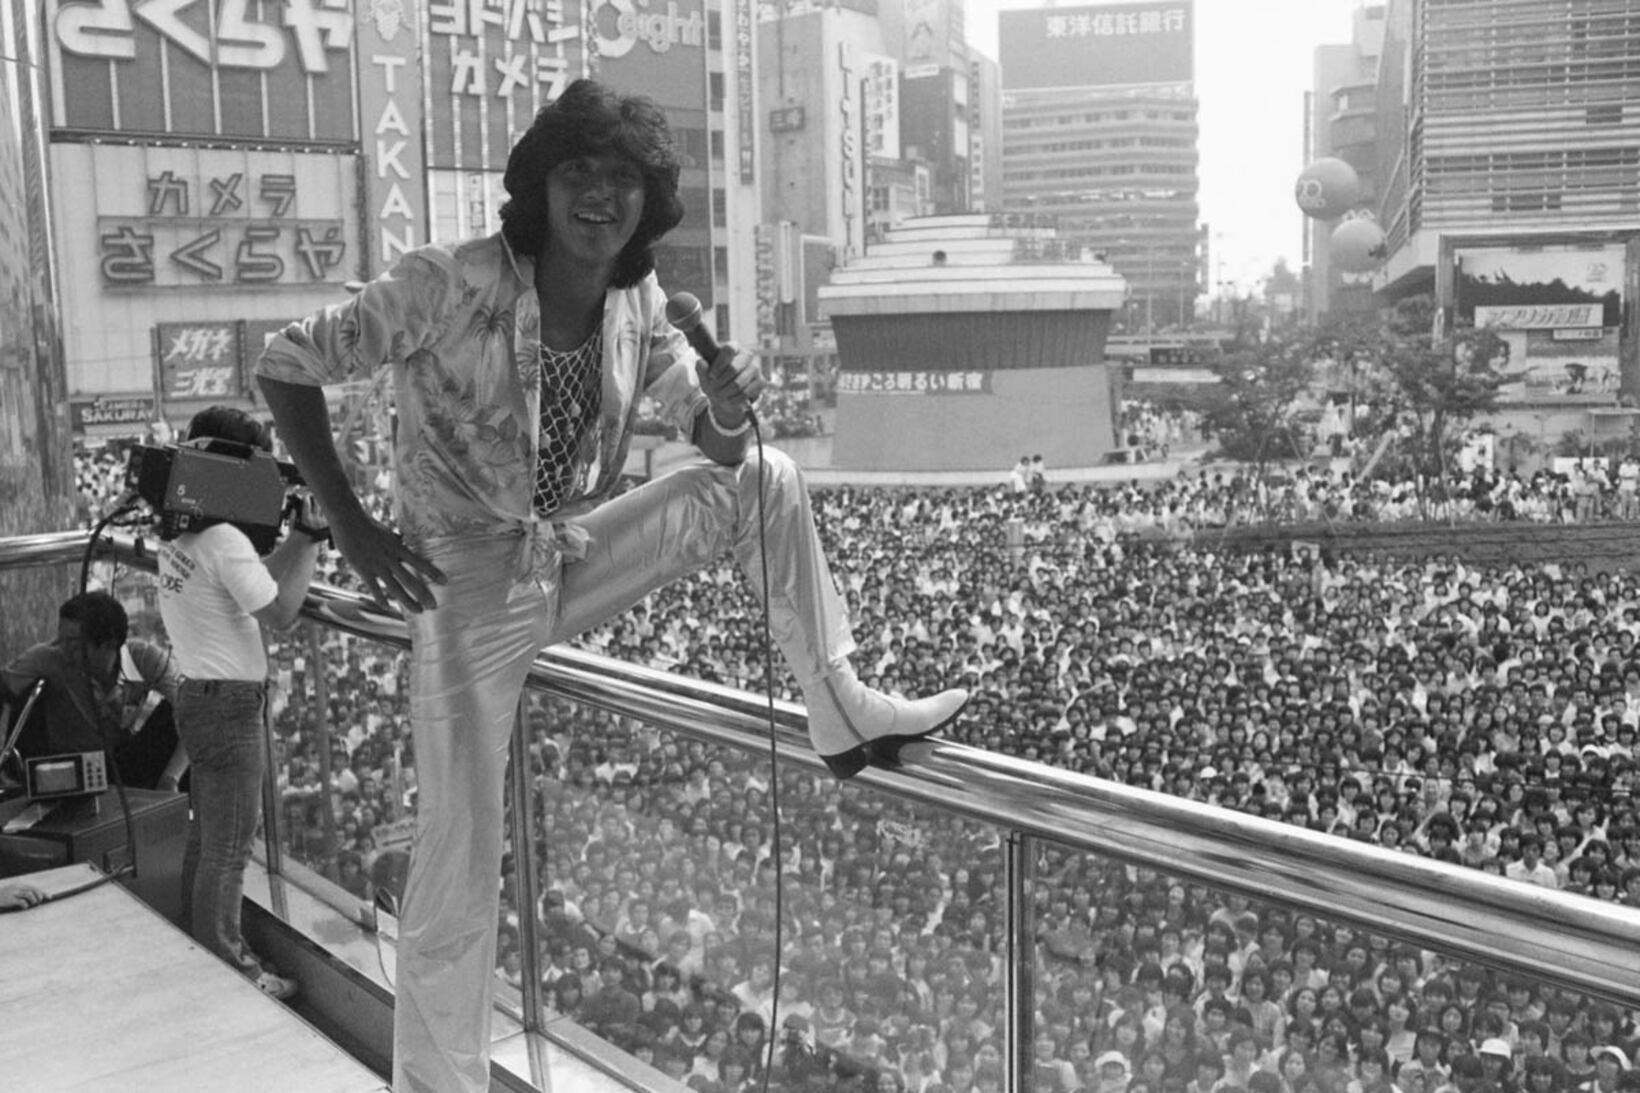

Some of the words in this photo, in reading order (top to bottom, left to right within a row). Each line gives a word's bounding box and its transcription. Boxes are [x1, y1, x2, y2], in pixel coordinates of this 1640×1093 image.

[56, 0, 354, 74] さくらや
[430, 0, 579, 42] ヨドバシ
[1047, 9, 1186, 38] 東洋信託銀行
[451, 48, 568, 100] カメラ
[147, 171, 296, 216] カメラ
[102, 227, 345, 281] さくらや
[163, 328, 233, 361] メガネ
